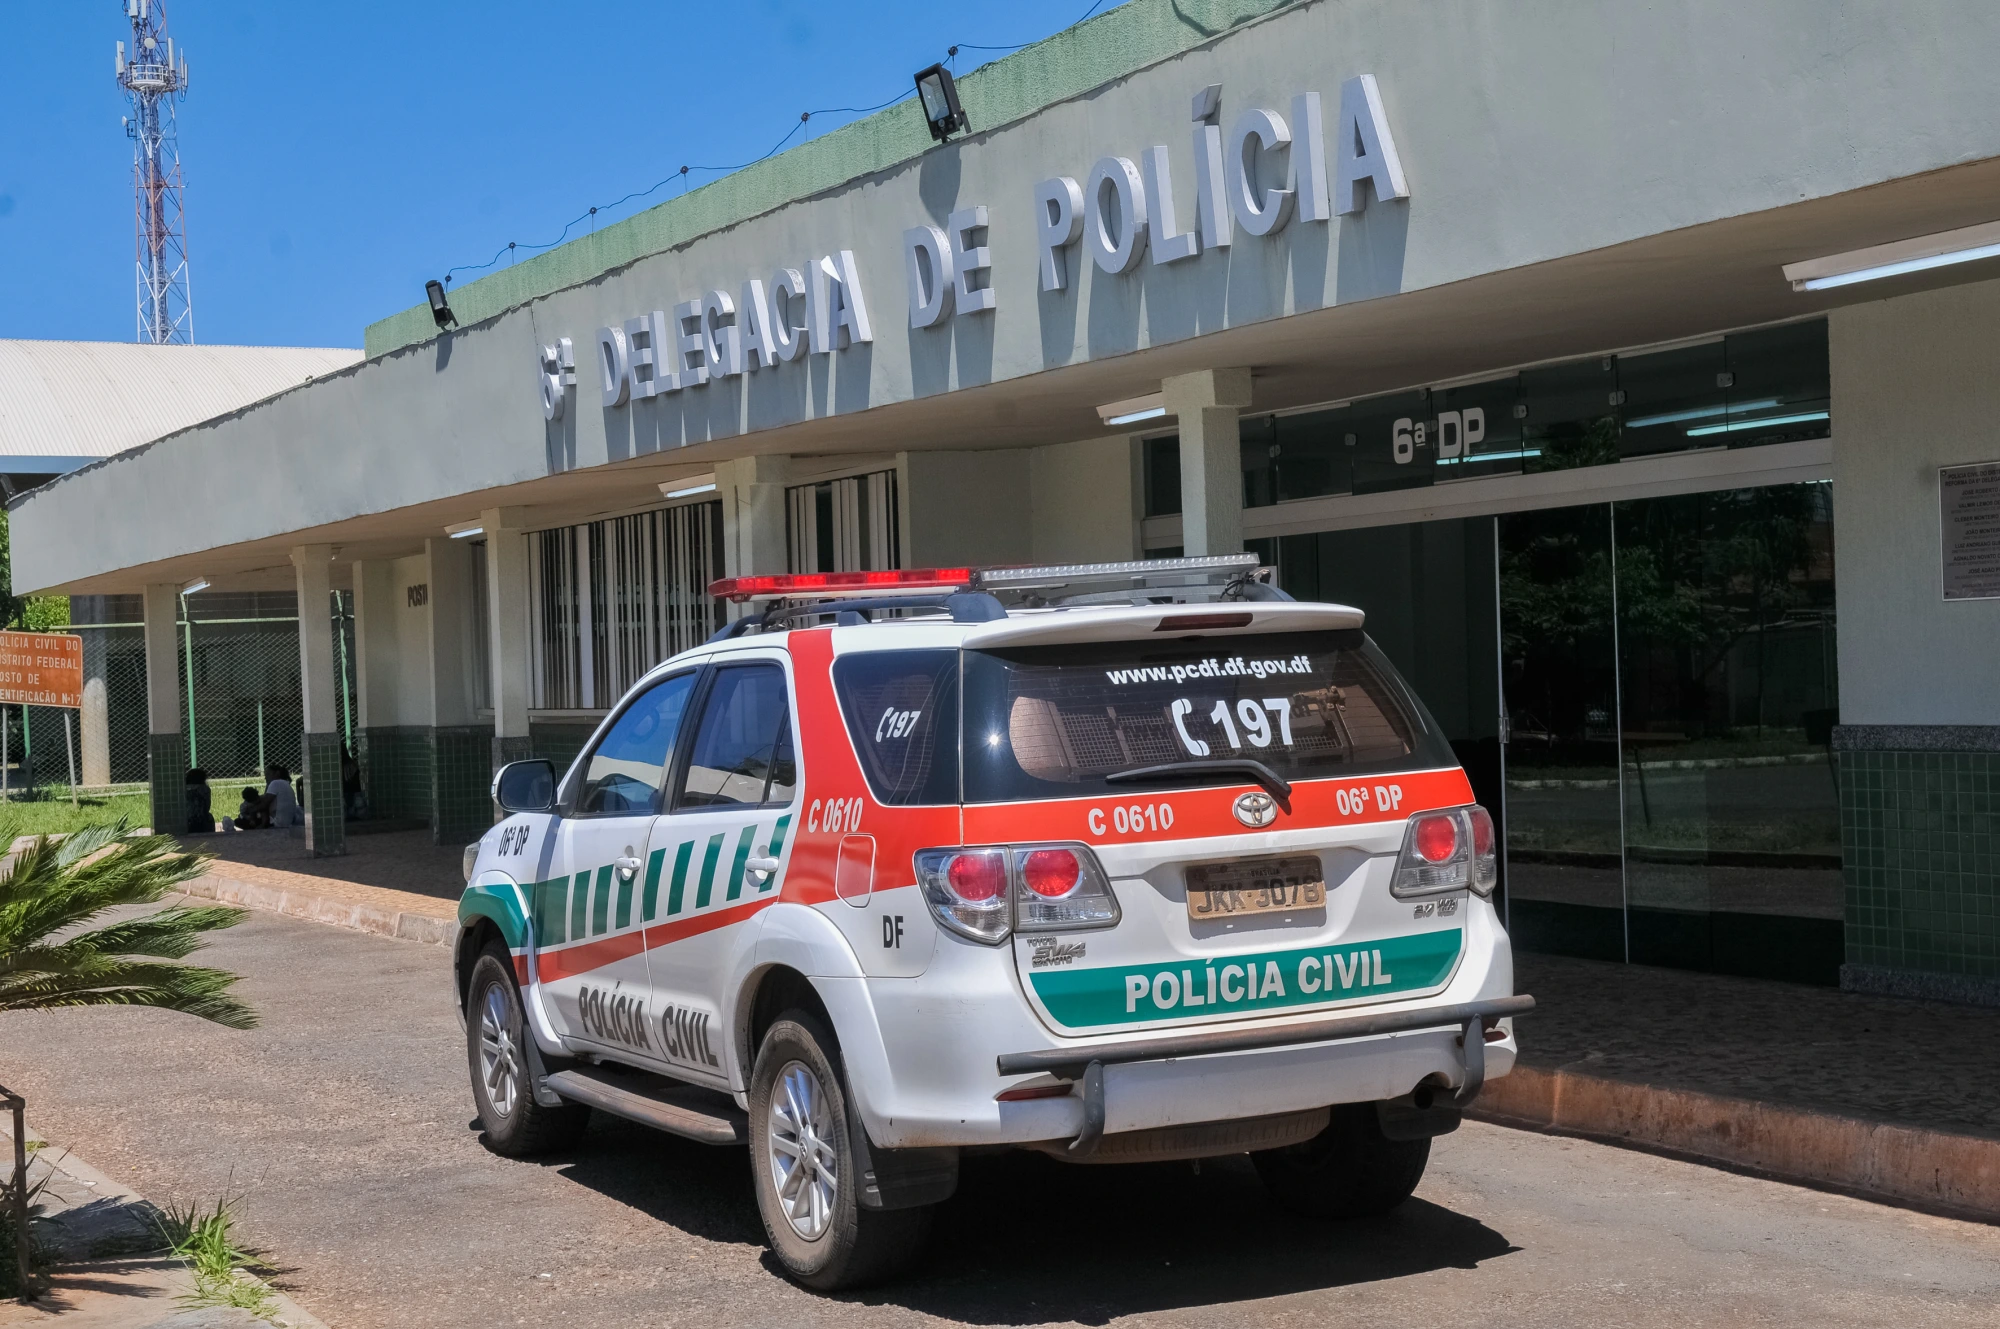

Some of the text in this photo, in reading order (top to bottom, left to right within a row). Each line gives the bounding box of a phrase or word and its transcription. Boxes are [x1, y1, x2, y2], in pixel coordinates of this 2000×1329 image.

[539, 73, 1411, 421] 6ª DELEGACIA DE POLÍCIA
[1392, 407, 1485, 464] 6ª DP
[1974, 513, 1999, 521] MONTEIRO
[0, 634, 78, 651] OLÍCIA CIVIL DO
[0, 654, 79, 670] ISTRITO FEDERAL
[0, 671, 40, 685] OSTO DE
[1106, 655, 1313, 685] www.pcdf.df.gov.df
[0, 688, 56, 704] ENTIFICAÇÃO
[886, 710, 921, 739] 197
[1210, 698, 1293, 749] 197
[808, 797, 863, 833] C 0610
[1336, 784, 1403, 816] 06ª DP
[1088, 803, 1174, 836] C 0610
[513, 824, 530, 856] DP
[883, 915, 904, 948] DF
[1034, 942, 1086, 959] SW4
[1124, 950, 1392, 1013] POLÍCIA CIVIL
[578, 980, 719, 1068] POLÍCIA CIVIL
